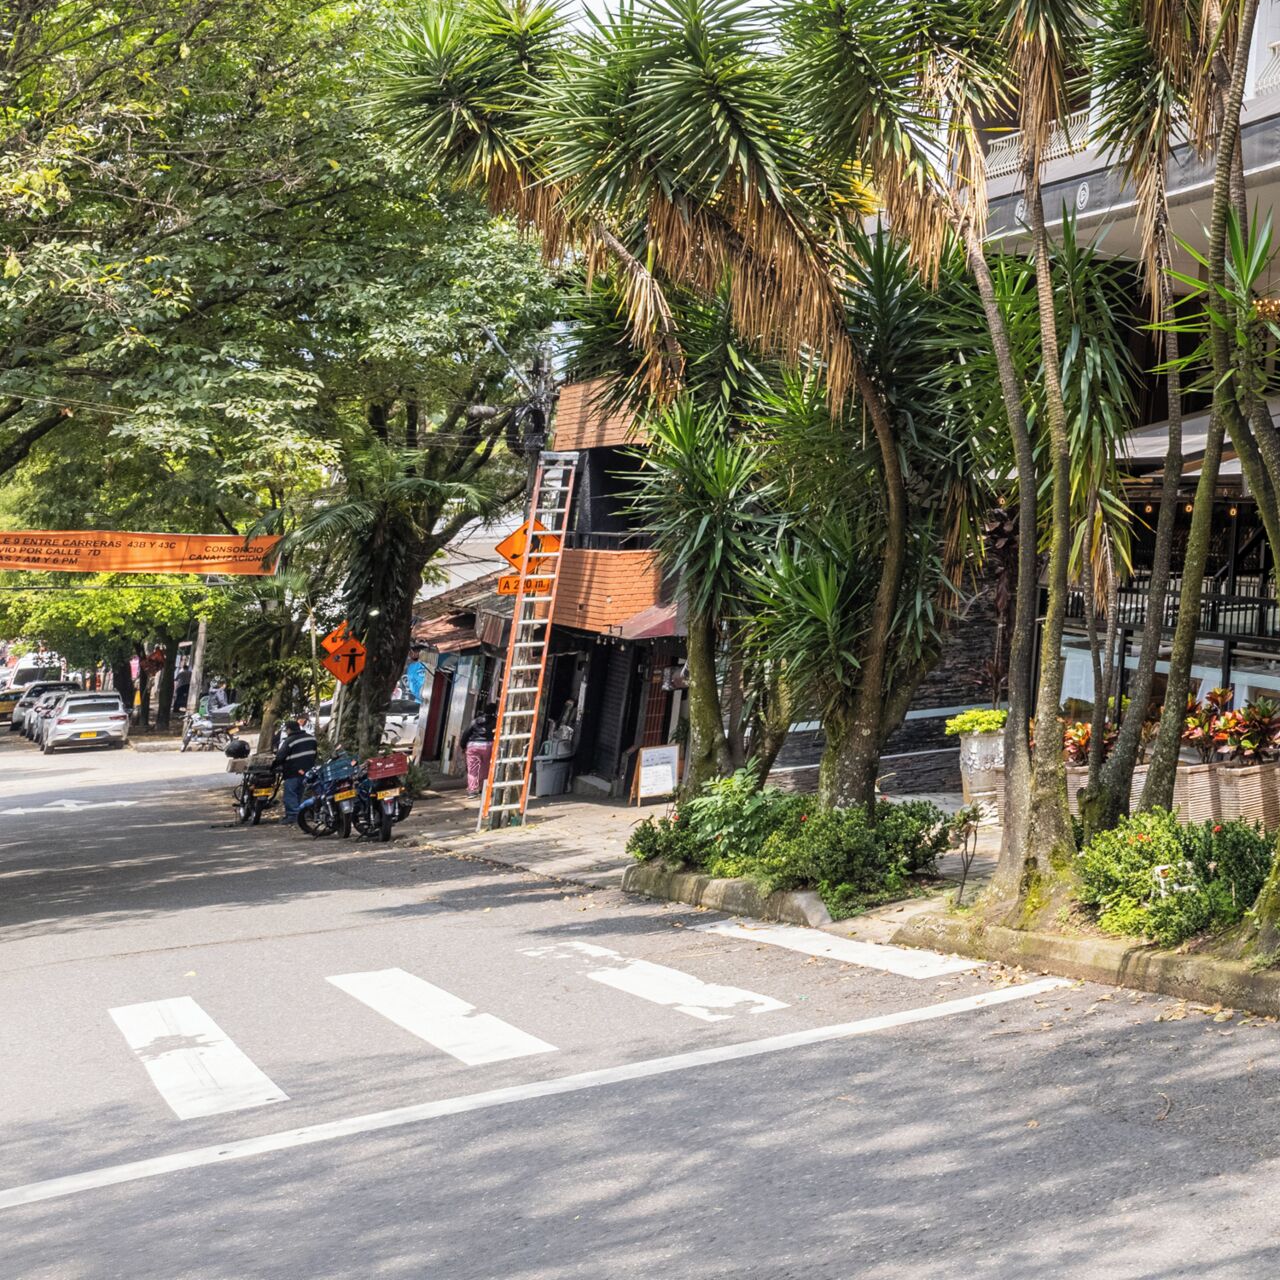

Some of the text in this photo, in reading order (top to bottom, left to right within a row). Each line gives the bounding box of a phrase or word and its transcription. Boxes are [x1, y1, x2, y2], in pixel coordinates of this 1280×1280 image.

[23, 538, 60, 546] ENTRE
[62, 540, 121, 548] CARRERAS
[19, 547, 42, 555] POR
[46, 548, 82, 556] CALLE
[88, 549, 101, 557] 7D
[503, 579, 511, 590] A
